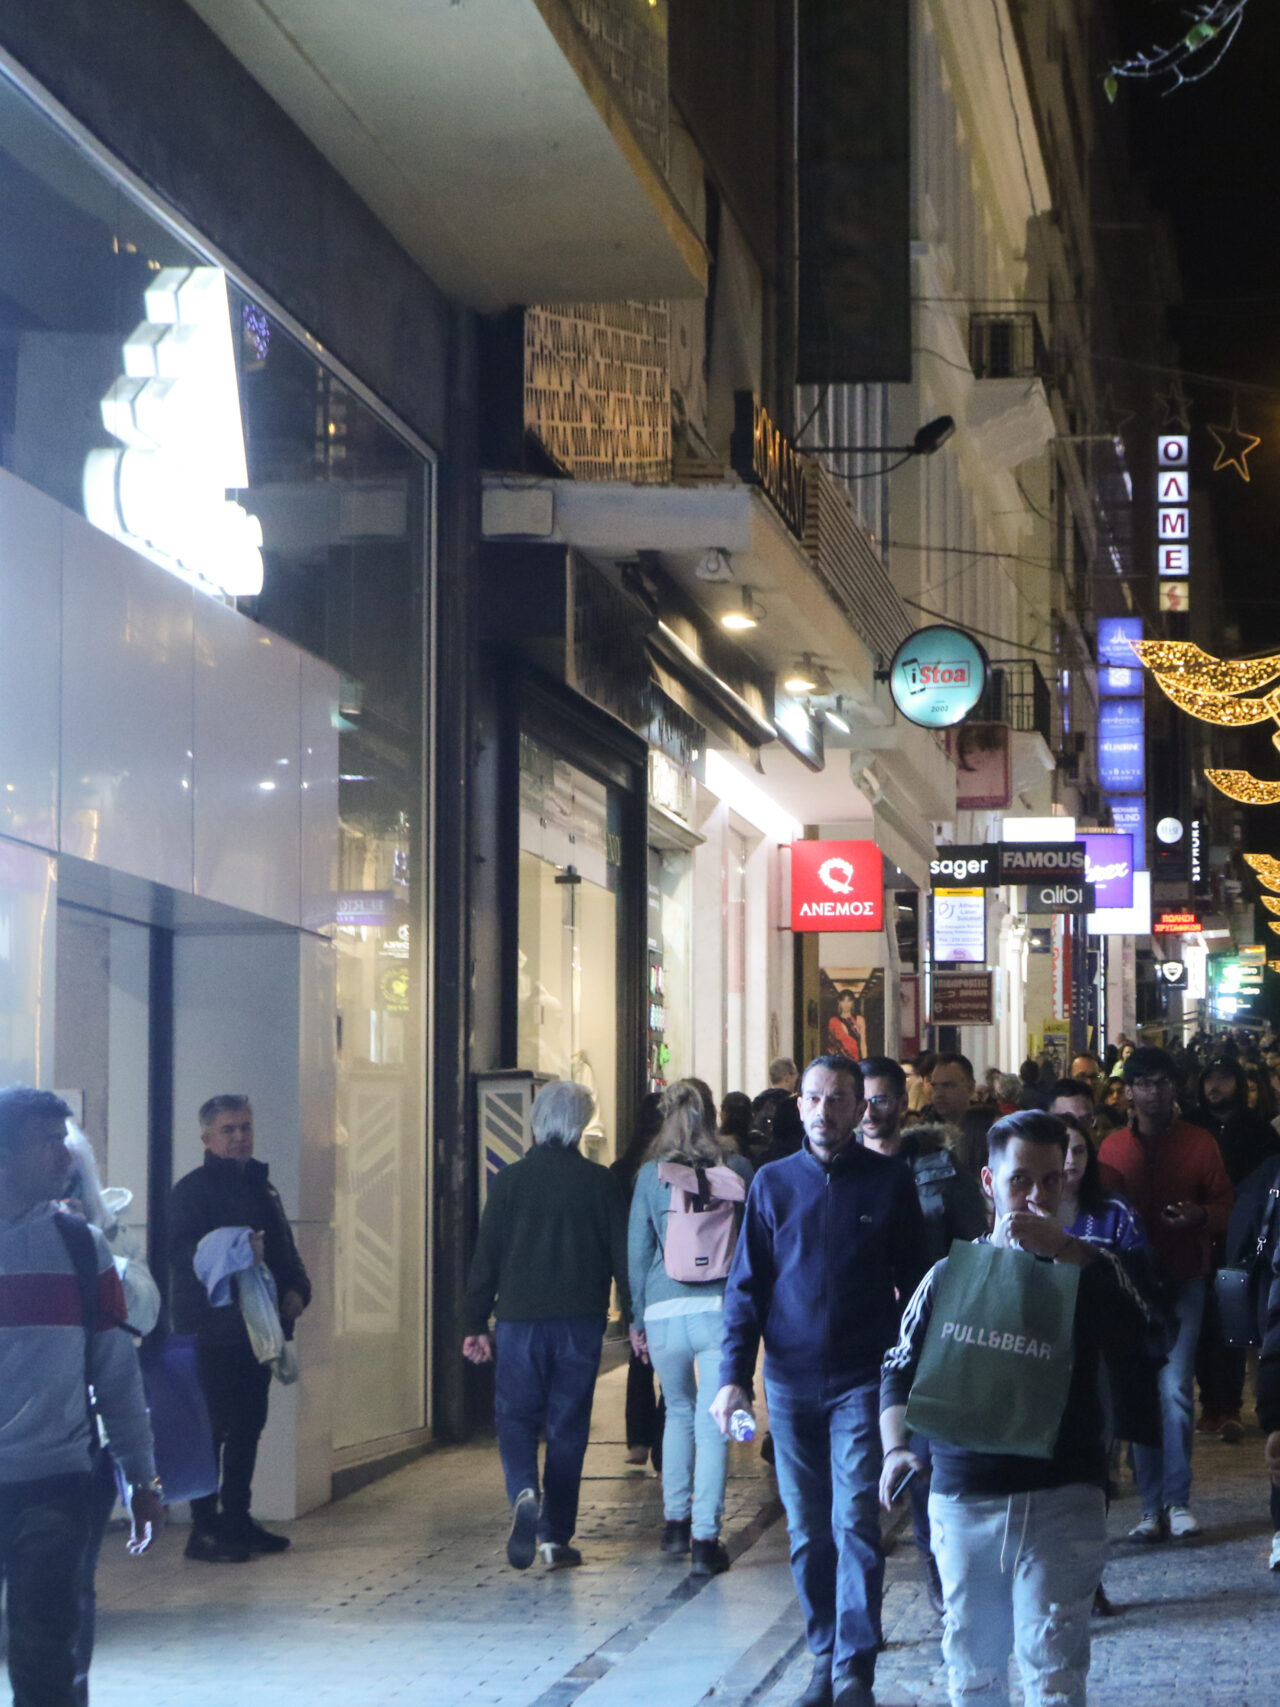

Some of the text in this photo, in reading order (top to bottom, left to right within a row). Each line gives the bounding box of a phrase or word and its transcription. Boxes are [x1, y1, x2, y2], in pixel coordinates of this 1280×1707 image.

[1003, 851, 1084, 868] FAMOUS
[930, 859, 989, 880] sager
[1040, 886, 1082, 904] alibi
[941, 1322, 1053, 1360] PULL&BEAR
